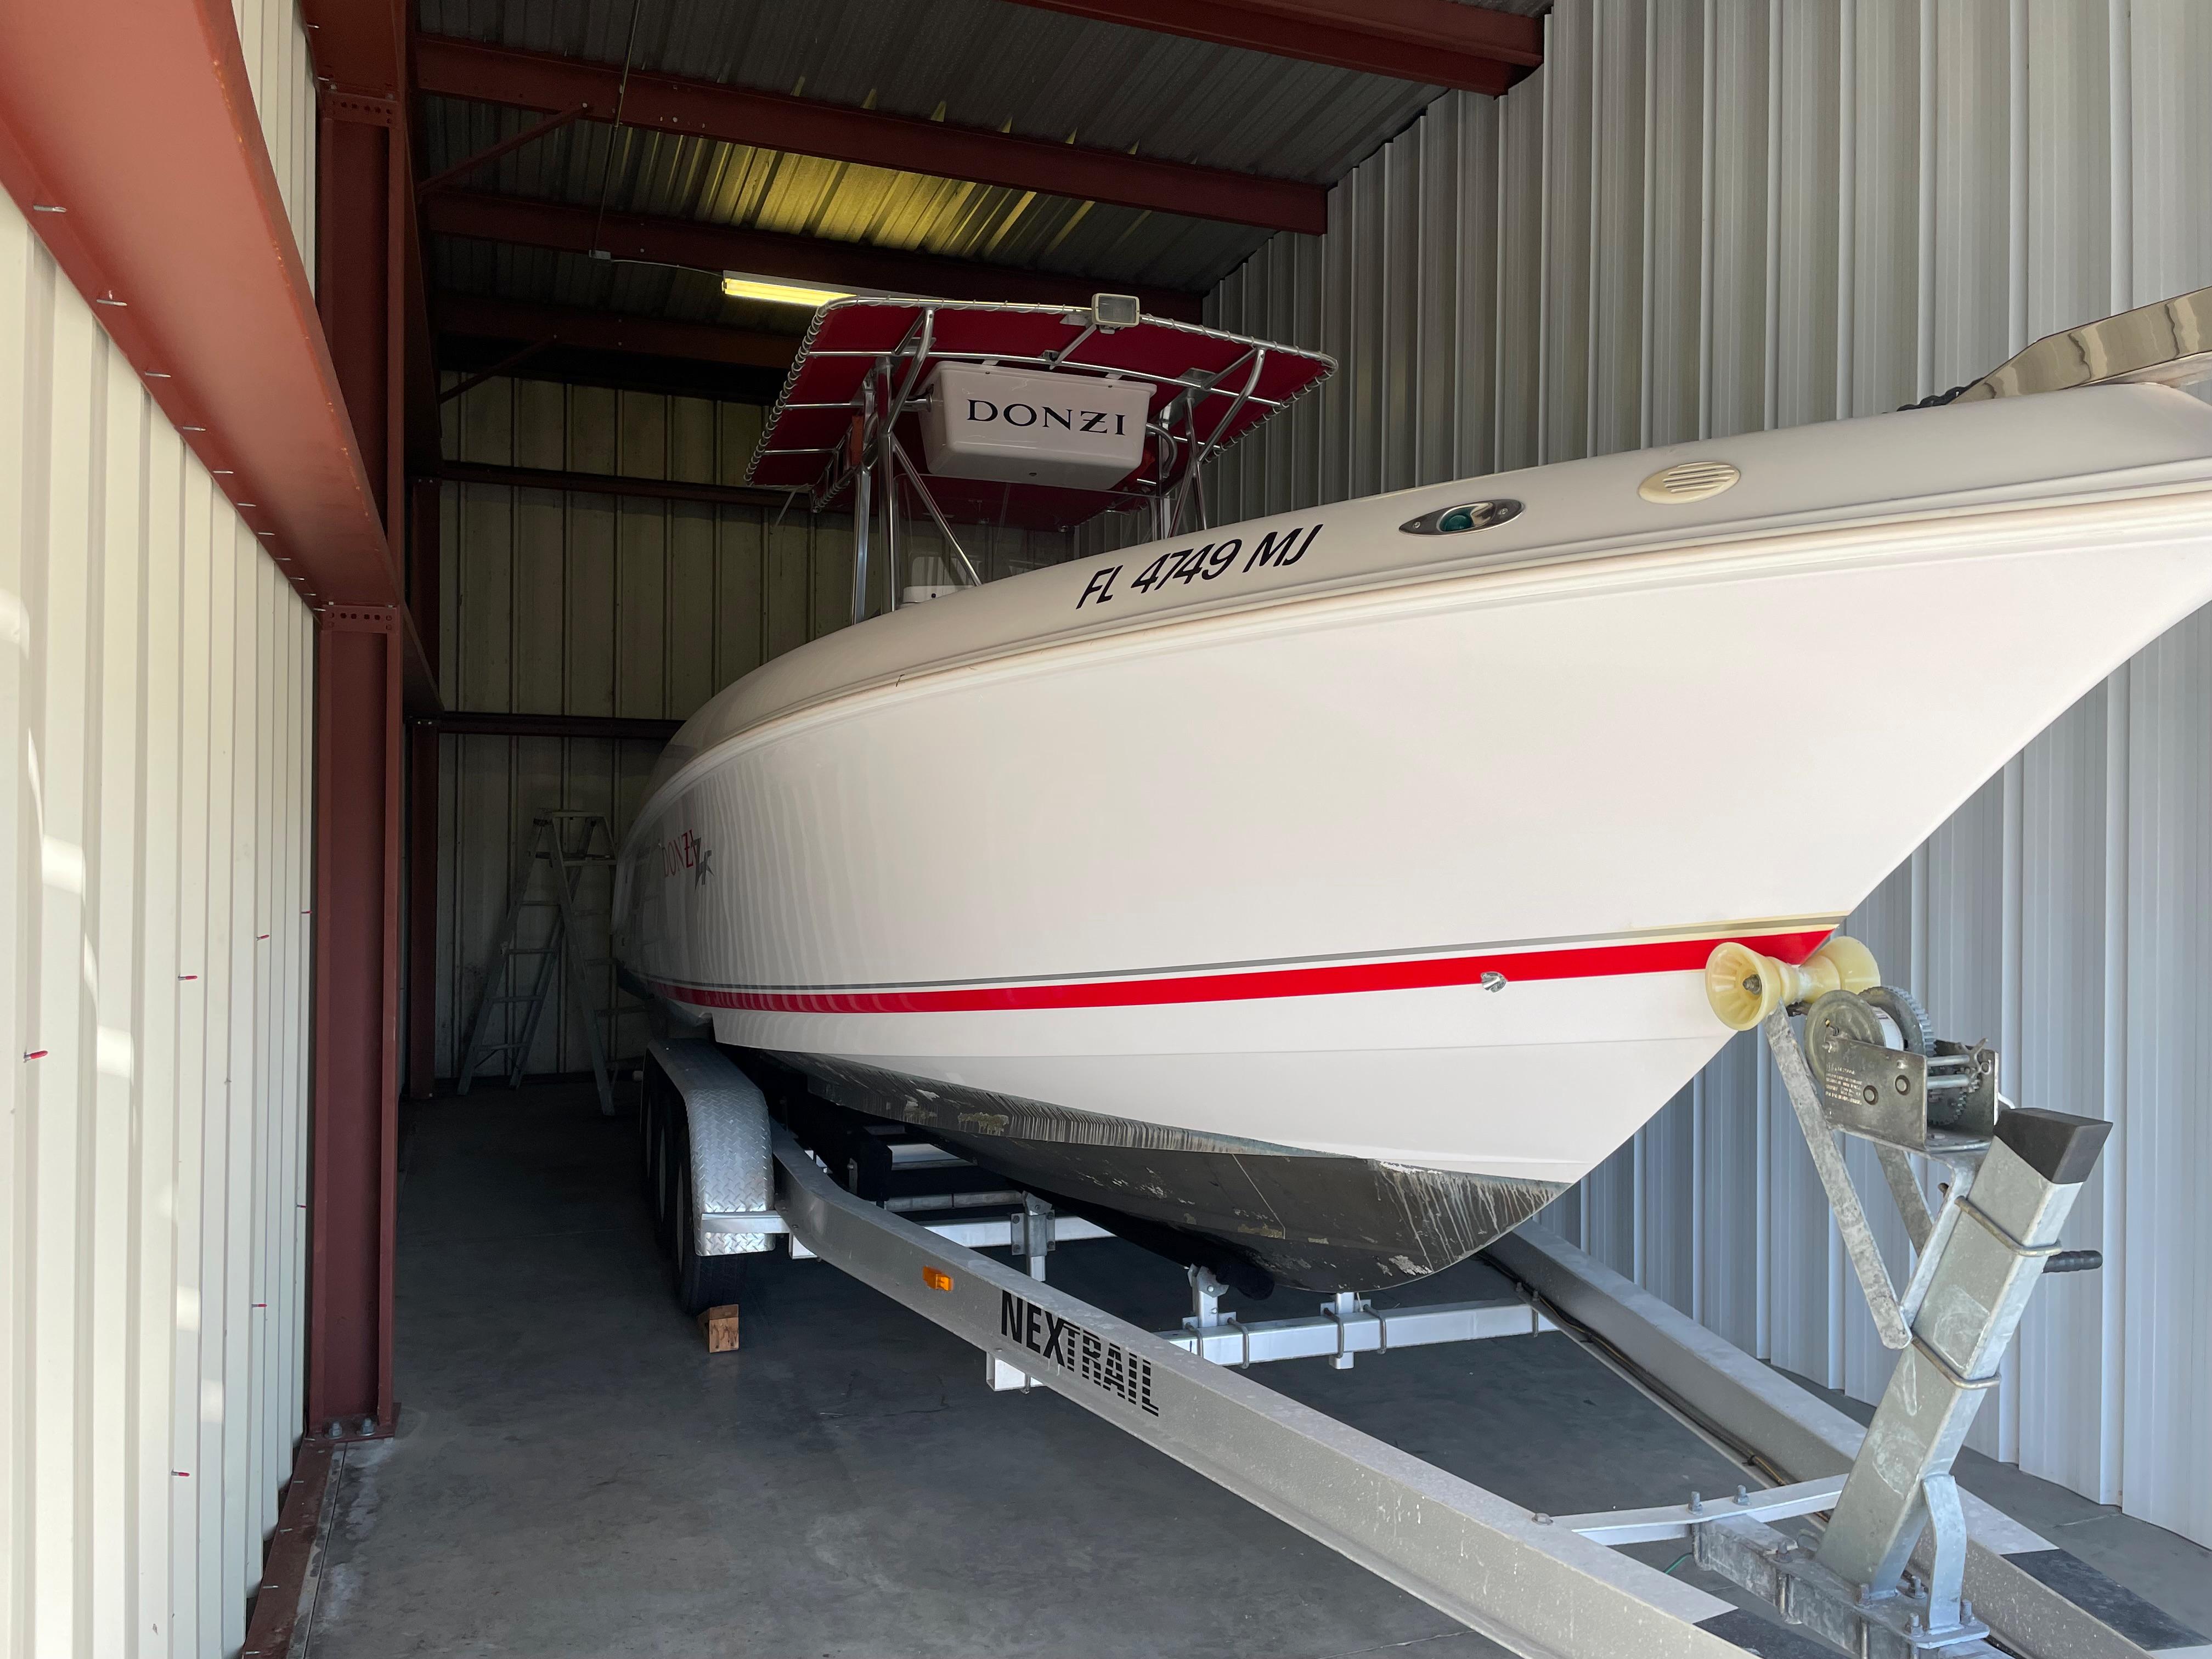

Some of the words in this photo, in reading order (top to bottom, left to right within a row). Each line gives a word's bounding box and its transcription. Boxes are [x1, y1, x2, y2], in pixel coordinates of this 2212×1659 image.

[967, 399, 1126, 436] DONZI
[1076, 565, 1124, 610] FL
[1131, 539, 1243, 594] 4749
[1243, 524, 1324, 573] MJ
[662, 829, 697, 878] DONZI
[1001, 1290, 1159, 1417] NEXTRAIL
